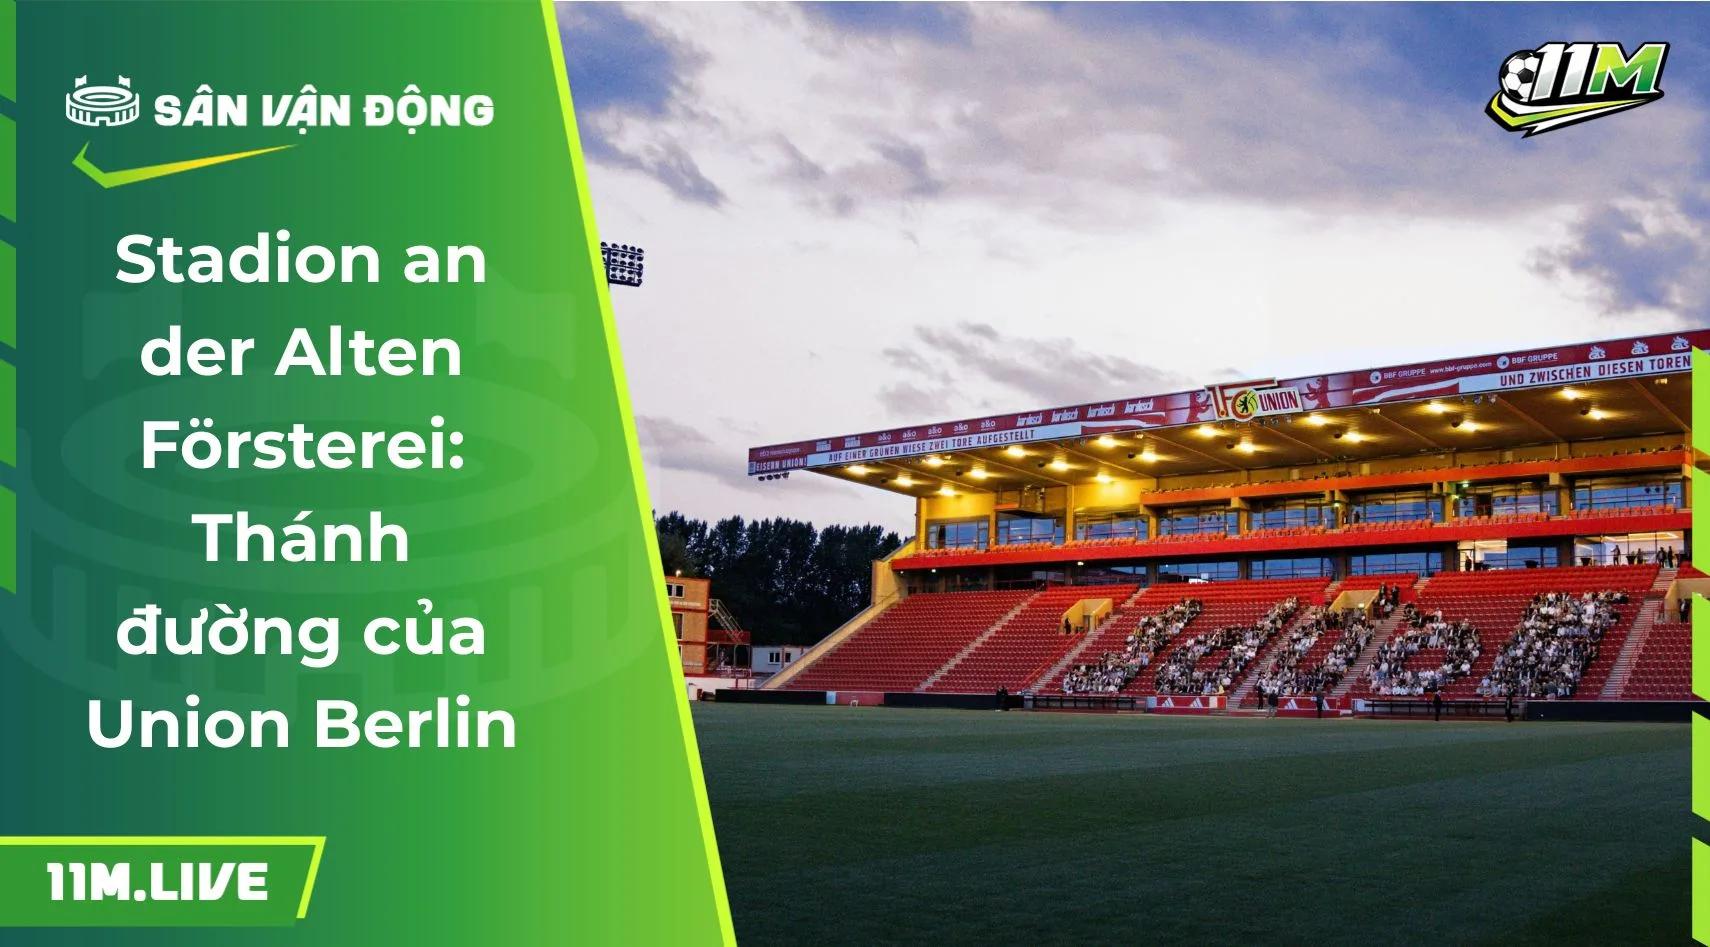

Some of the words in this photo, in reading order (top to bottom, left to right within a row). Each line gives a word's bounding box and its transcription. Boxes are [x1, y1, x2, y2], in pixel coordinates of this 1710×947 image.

[1527, 353, 1558, 362] GRUPPE
[1398, 368, 1426, 377] GRUPPE
[1500, 373, 1524, 386] UND
[1529, 366, 1591, 383] ZWISCHEN
[1598, 360, 1643, 376] DIESEN
[1649, 355, 1691, 370] TOREN
[1259, 391, 1298, 411] UNION
[829, 452, 842, 462] AUF
[845, 450, 867, 460] EINER
[902, 443, 926, 454] WIESE
[929, 440, 948, 451] ZWEI
[952, 437, 972, 447] TORE
[976, 430, 1035, 445] AUFGESTELLT
[756, 460, 780, 471] EISERN
[782, 456, 807, 469] UNION!
